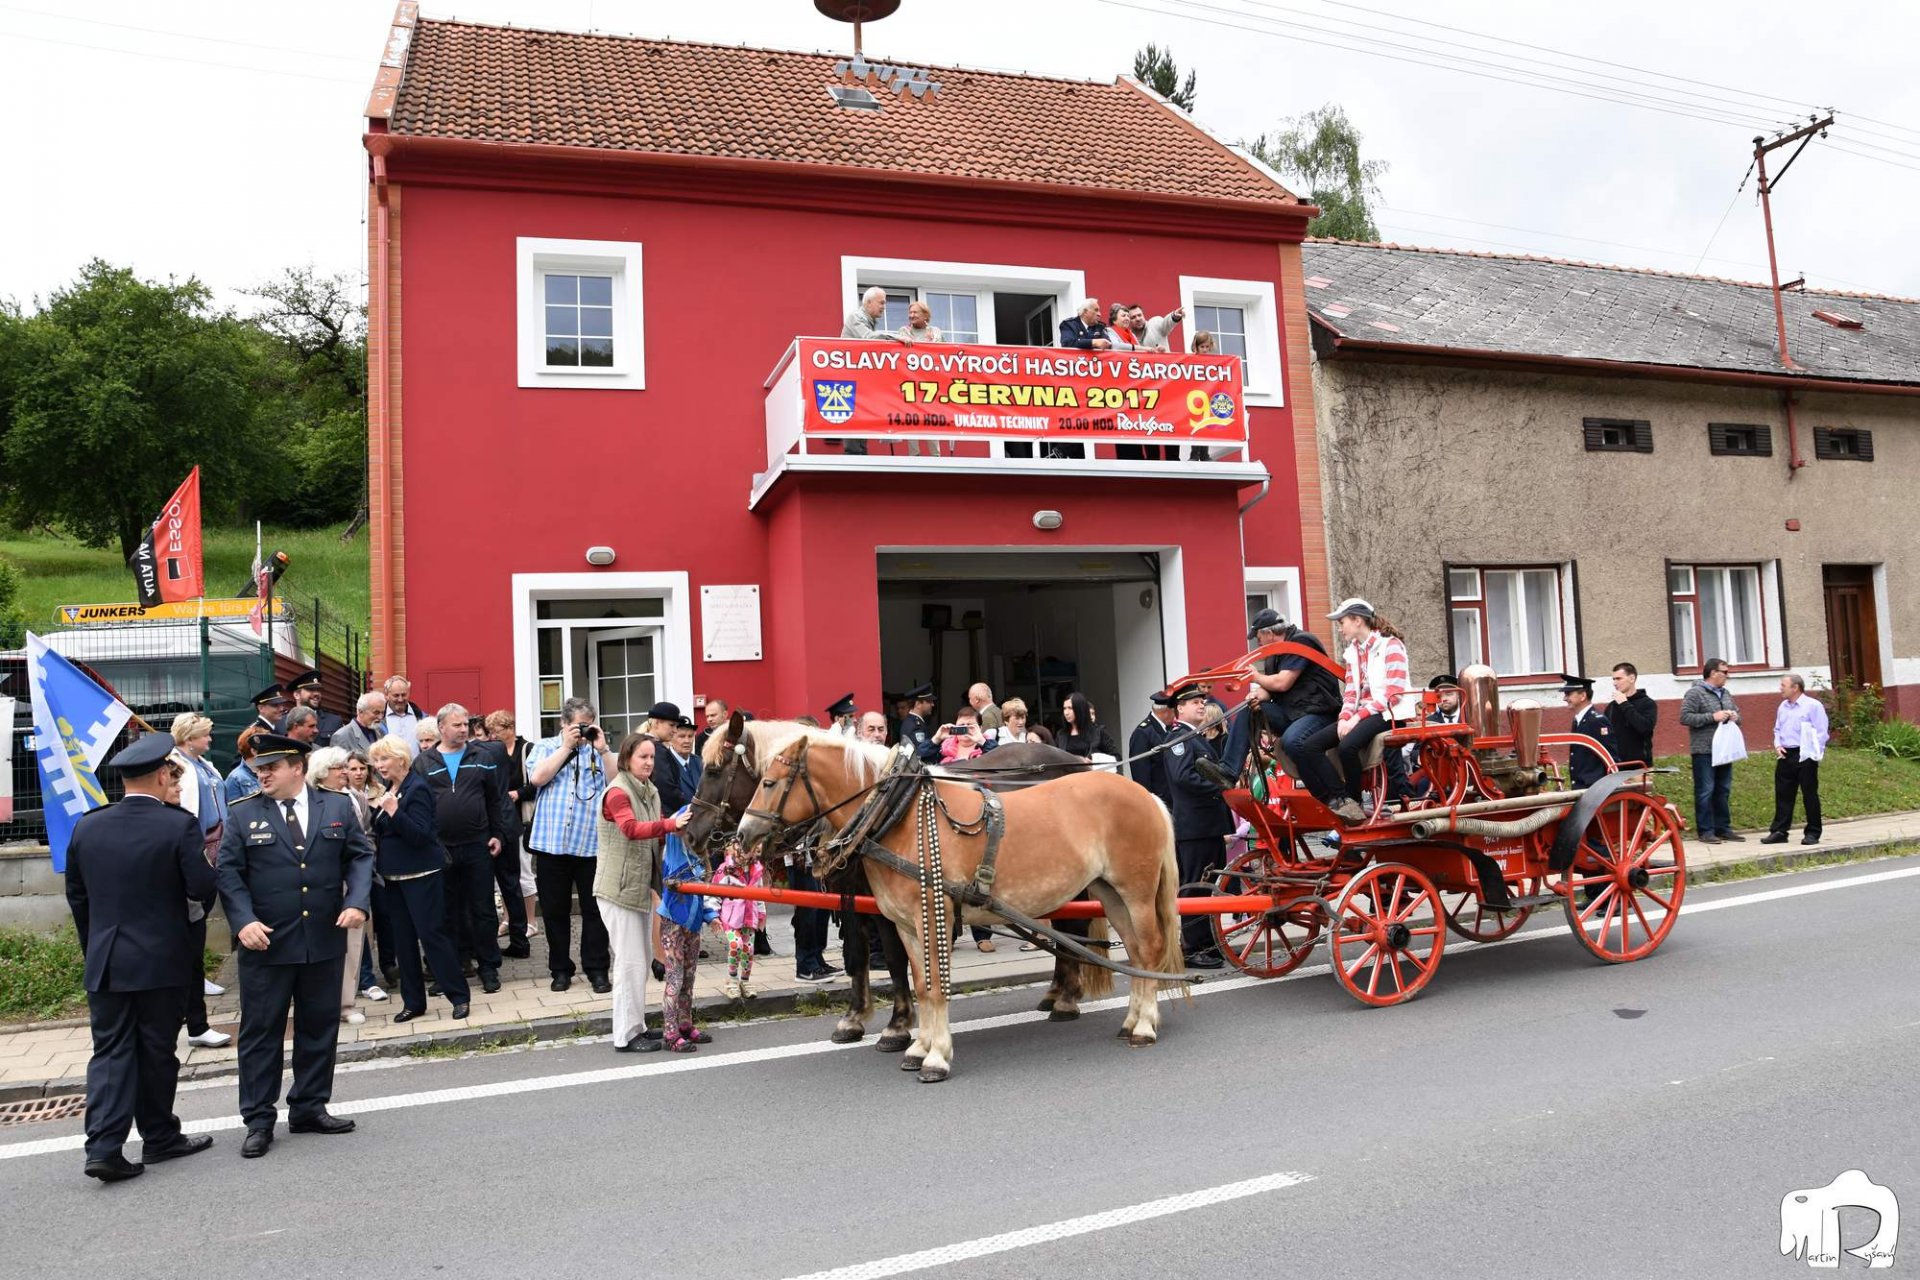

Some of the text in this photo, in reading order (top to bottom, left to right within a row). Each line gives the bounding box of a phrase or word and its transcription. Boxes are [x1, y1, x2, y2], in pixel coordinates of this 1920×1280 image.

[812, 349, 1232, 382] OSLAVY 90.VÝROČÍ HASIČŮ V ŠAROVECH
[900, 378, 1160, 410] 17.ČERVNA 2017
[887, 412, 920, 426] 14.00
[953, 411, 998, 429] UKÁZKA
[1000, 415, 1050, 430] TECHNIKY
[1059, 417, 1090, 430] 20.00
[80, 606, 147, 619] JUNKERS
